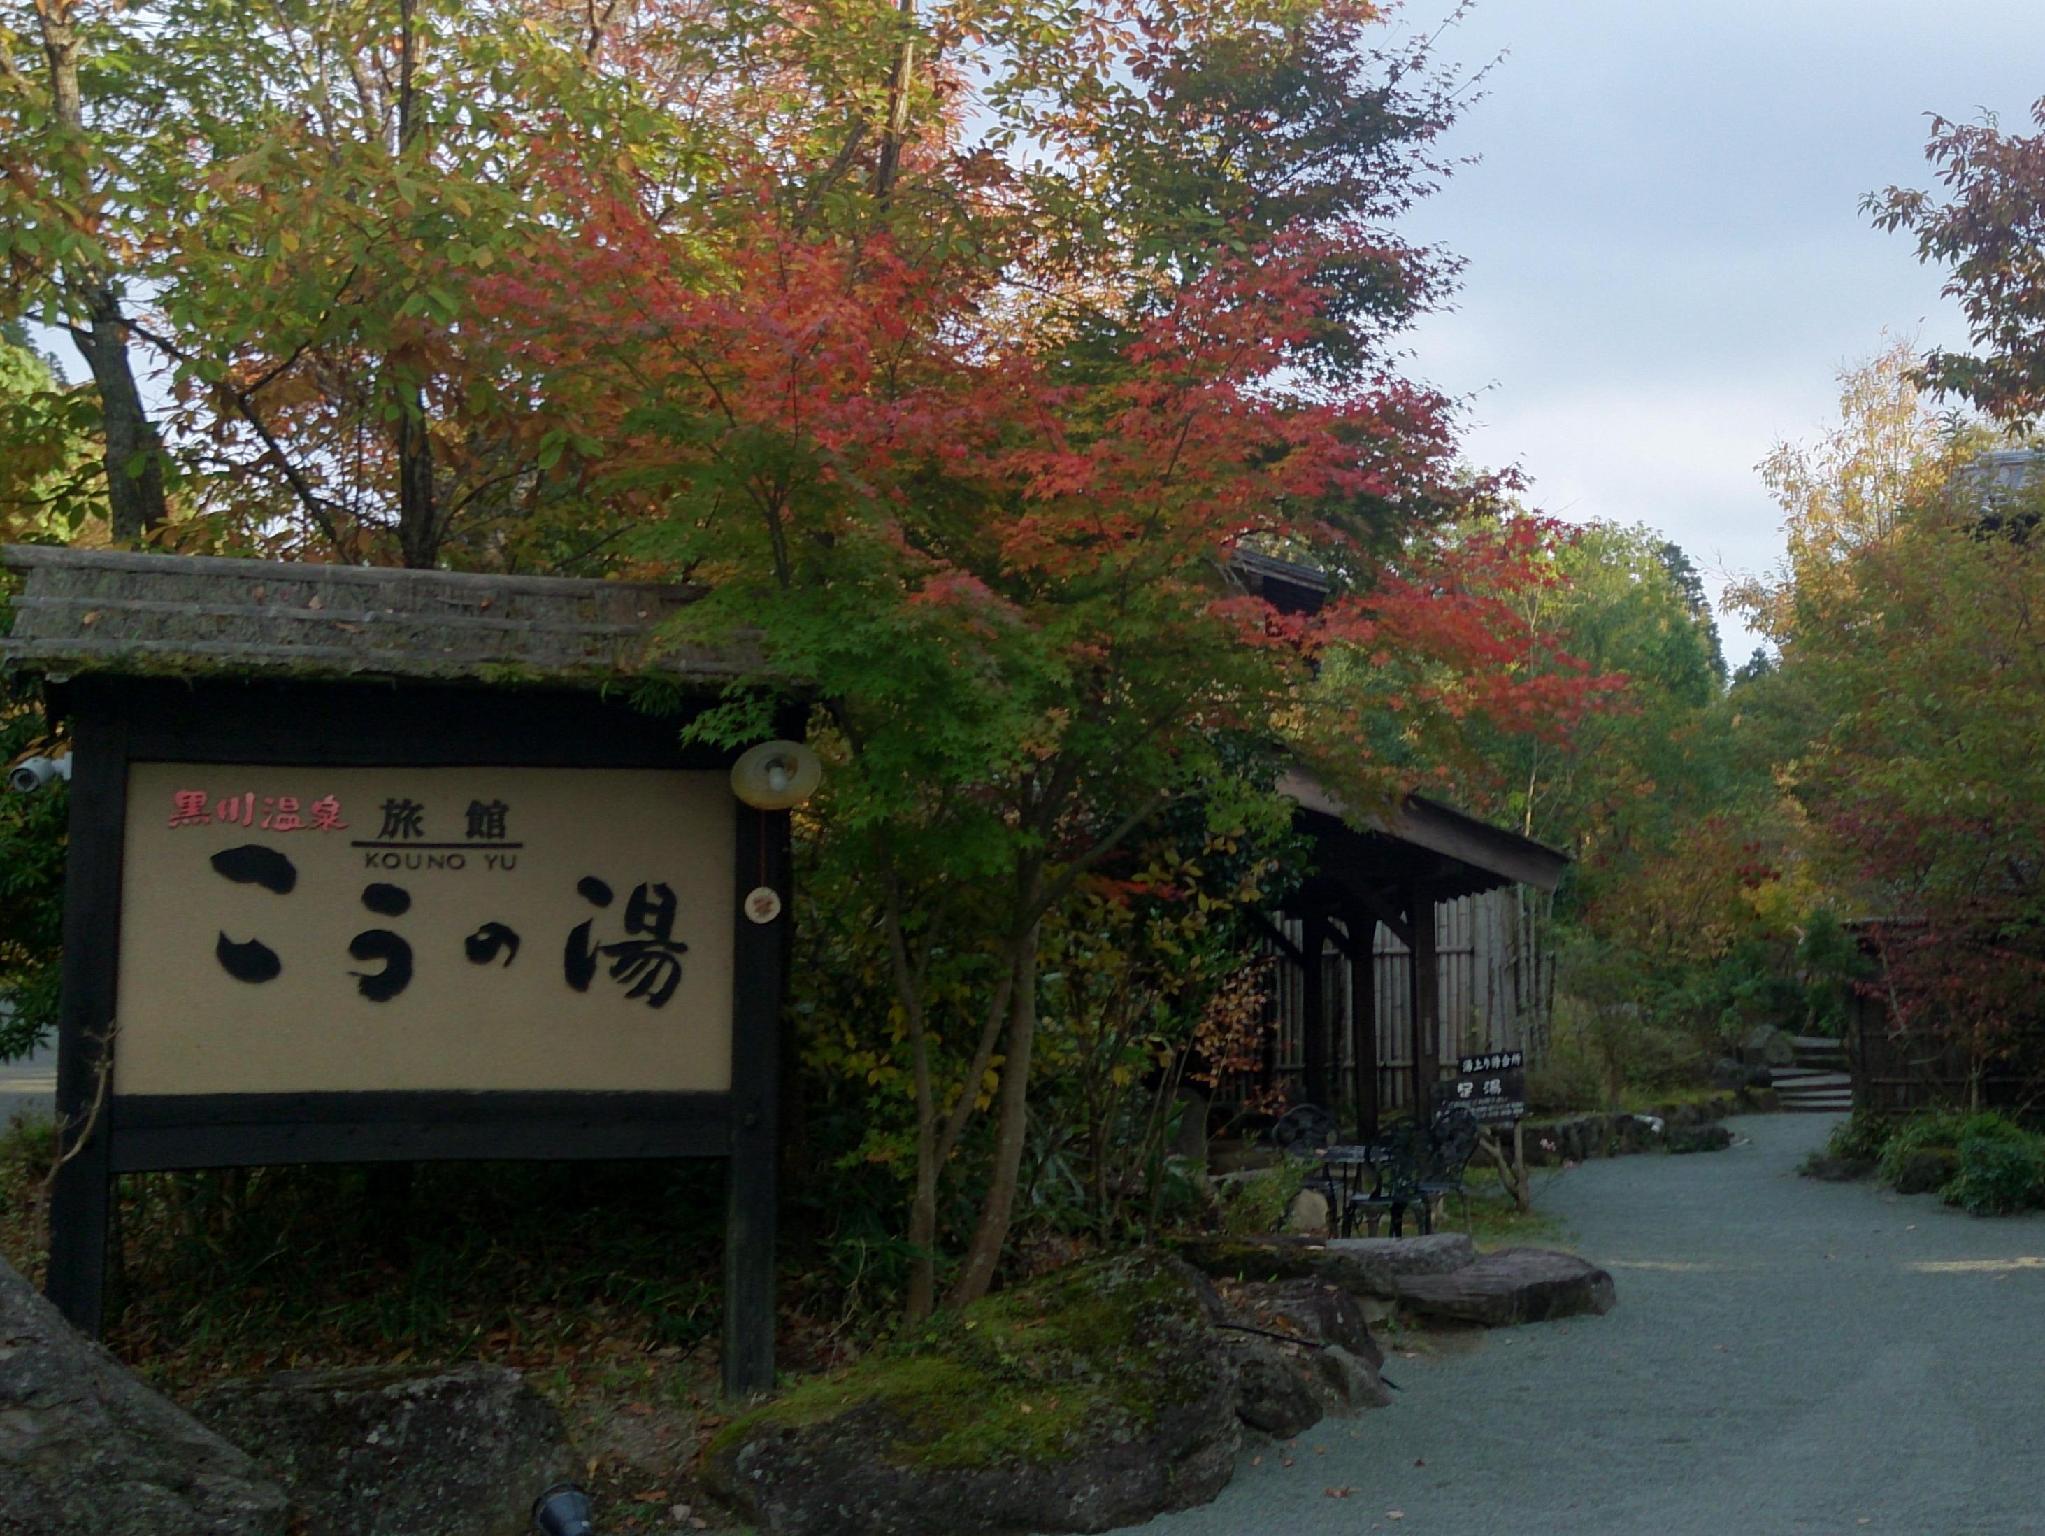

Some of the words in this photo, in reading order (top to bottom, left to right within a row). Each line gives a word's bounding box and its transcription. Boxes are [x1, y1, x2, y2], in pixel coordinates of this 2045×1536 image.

[167, 790, 350, 832] 黒川温泉
[377, 796, 512, 840] 旅館
[364, 851, 467, 872] KOUNO
[483, 852, 518, 872] YU
[209, 843, 690, 1010] こうの湯
